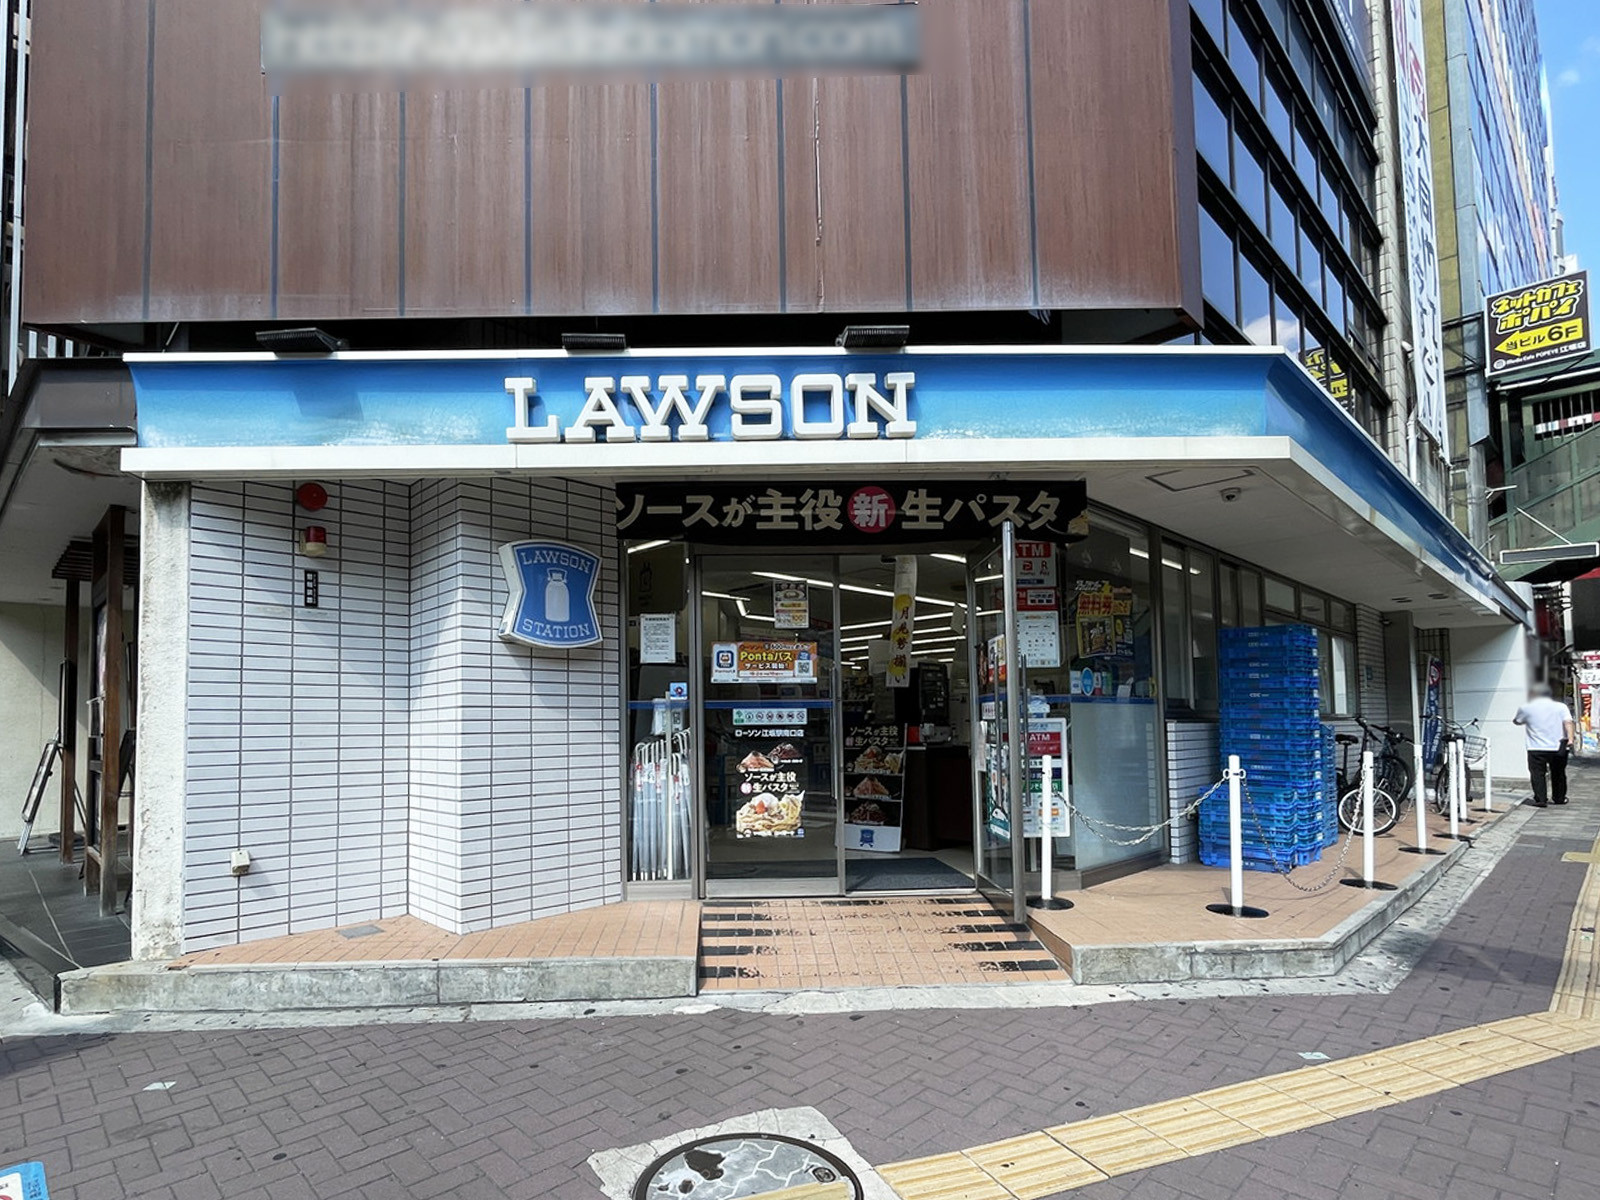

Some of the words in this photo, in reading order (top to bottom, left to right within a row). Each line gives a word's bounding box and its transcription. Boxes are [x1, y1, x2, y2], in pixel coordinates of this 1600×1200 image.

[1494, 281, 1581, 315] ネットカフェ
[1499, 297, 1577, 332] ポパイ
[504, 372, 917, 443] LAWSON
[521, 549, 591, 574] LAWSON
[522, 618, 591, 638] STATION
[740, 651, 793, 661] Pontaパス
[1029, 733, 1051, 741] ATM
[744, 771, 797, 783] ソースが主役
